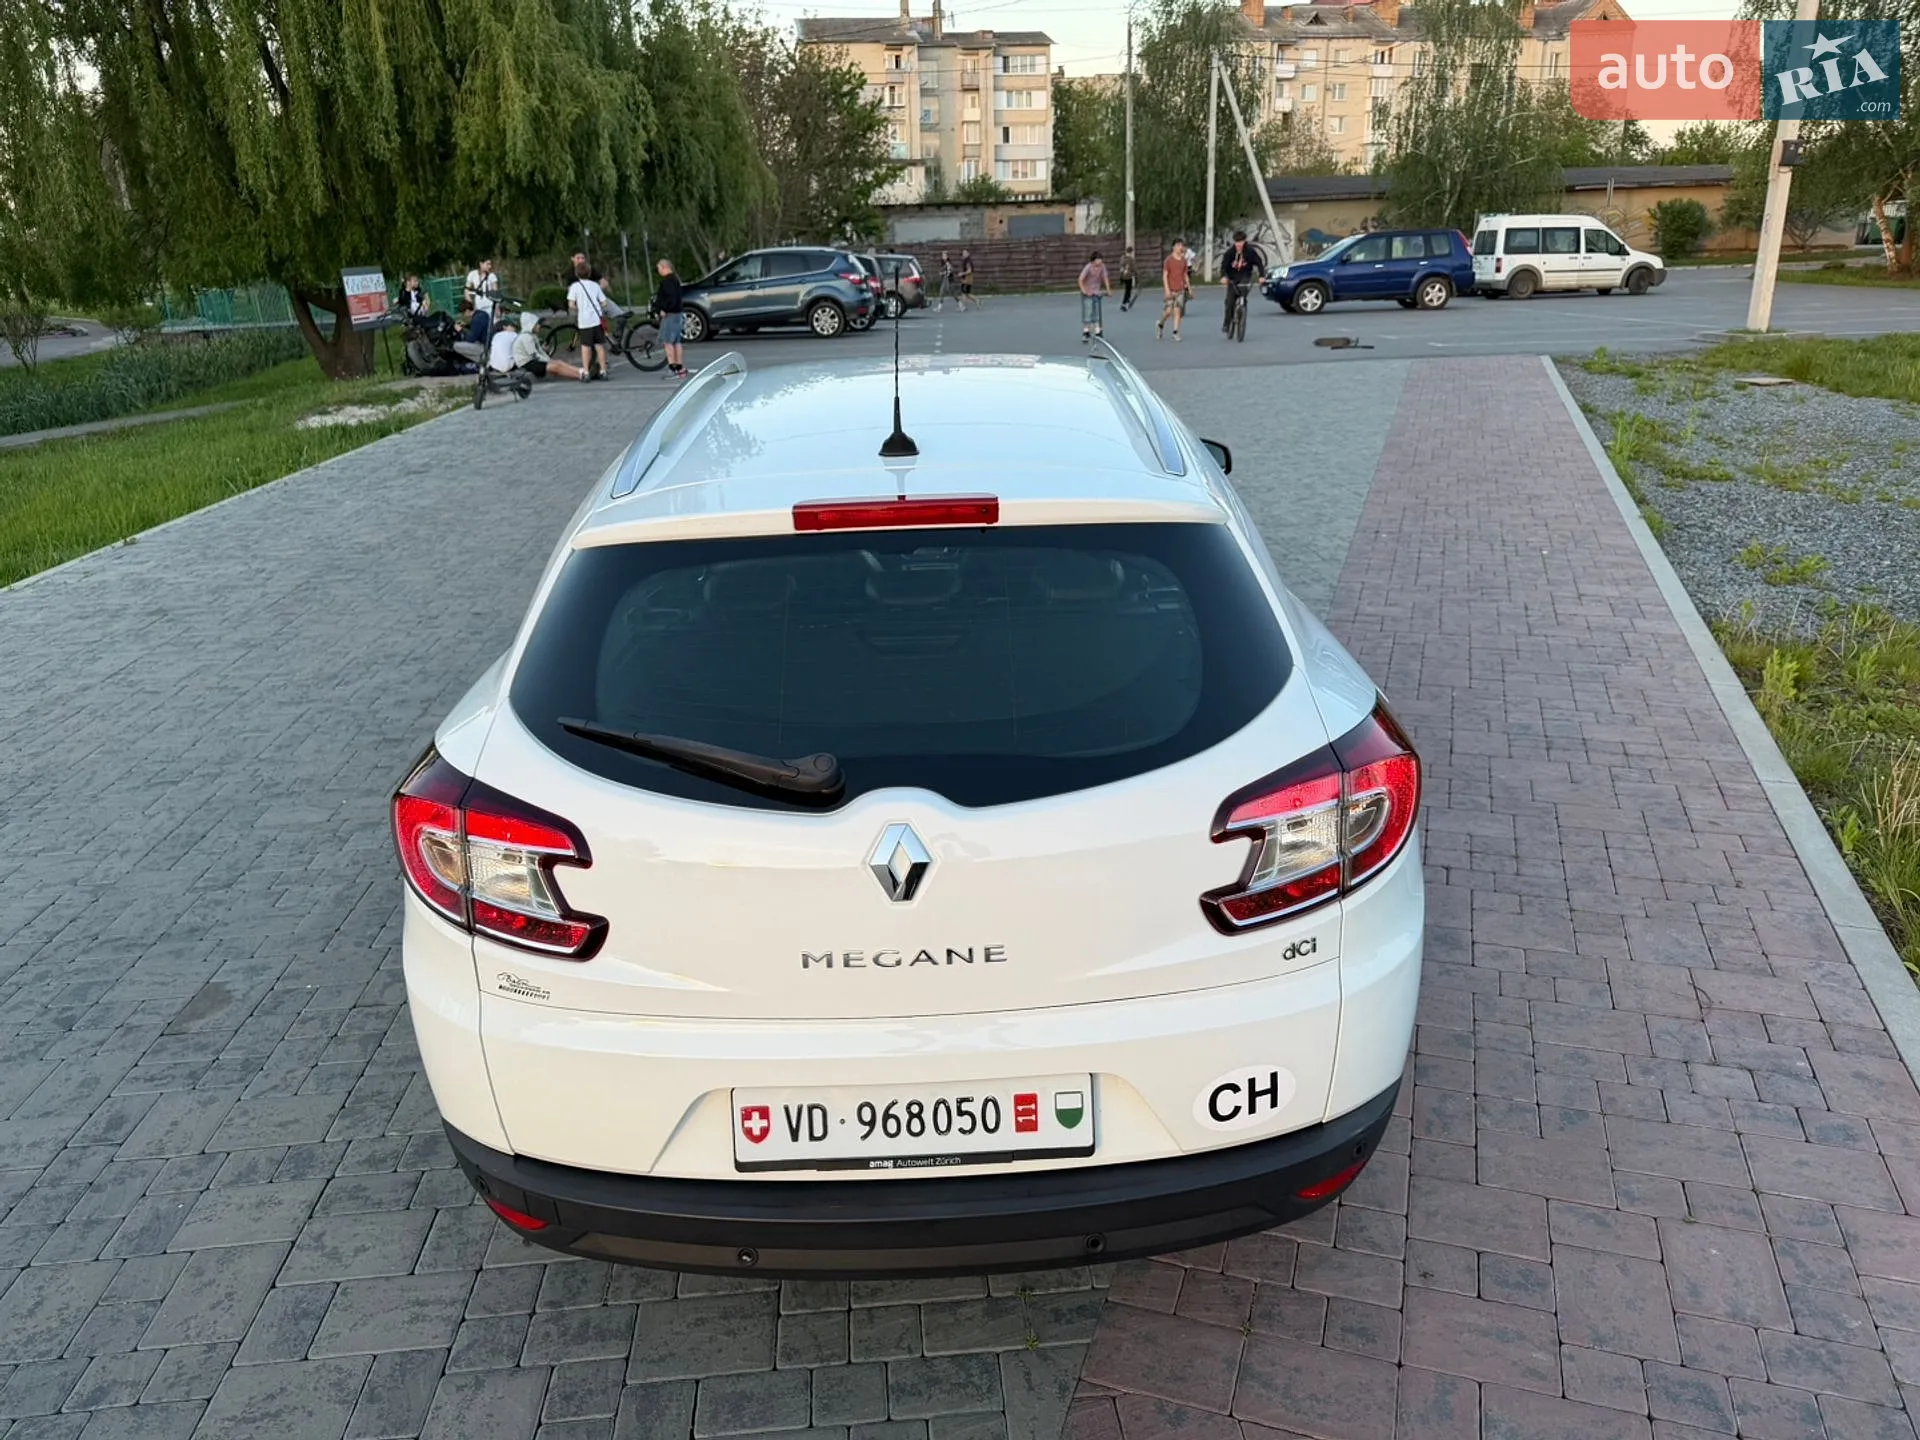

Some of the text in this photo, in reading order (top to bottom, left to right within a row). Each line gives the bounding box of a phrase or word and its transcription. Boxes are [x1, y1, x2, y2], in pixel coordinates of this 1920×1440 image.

[800, 944, 1009, 969] MEGANE
[783, 1096, 1001, 1143] VD 968050
[1208, 1070, 1279, 1123] CH
